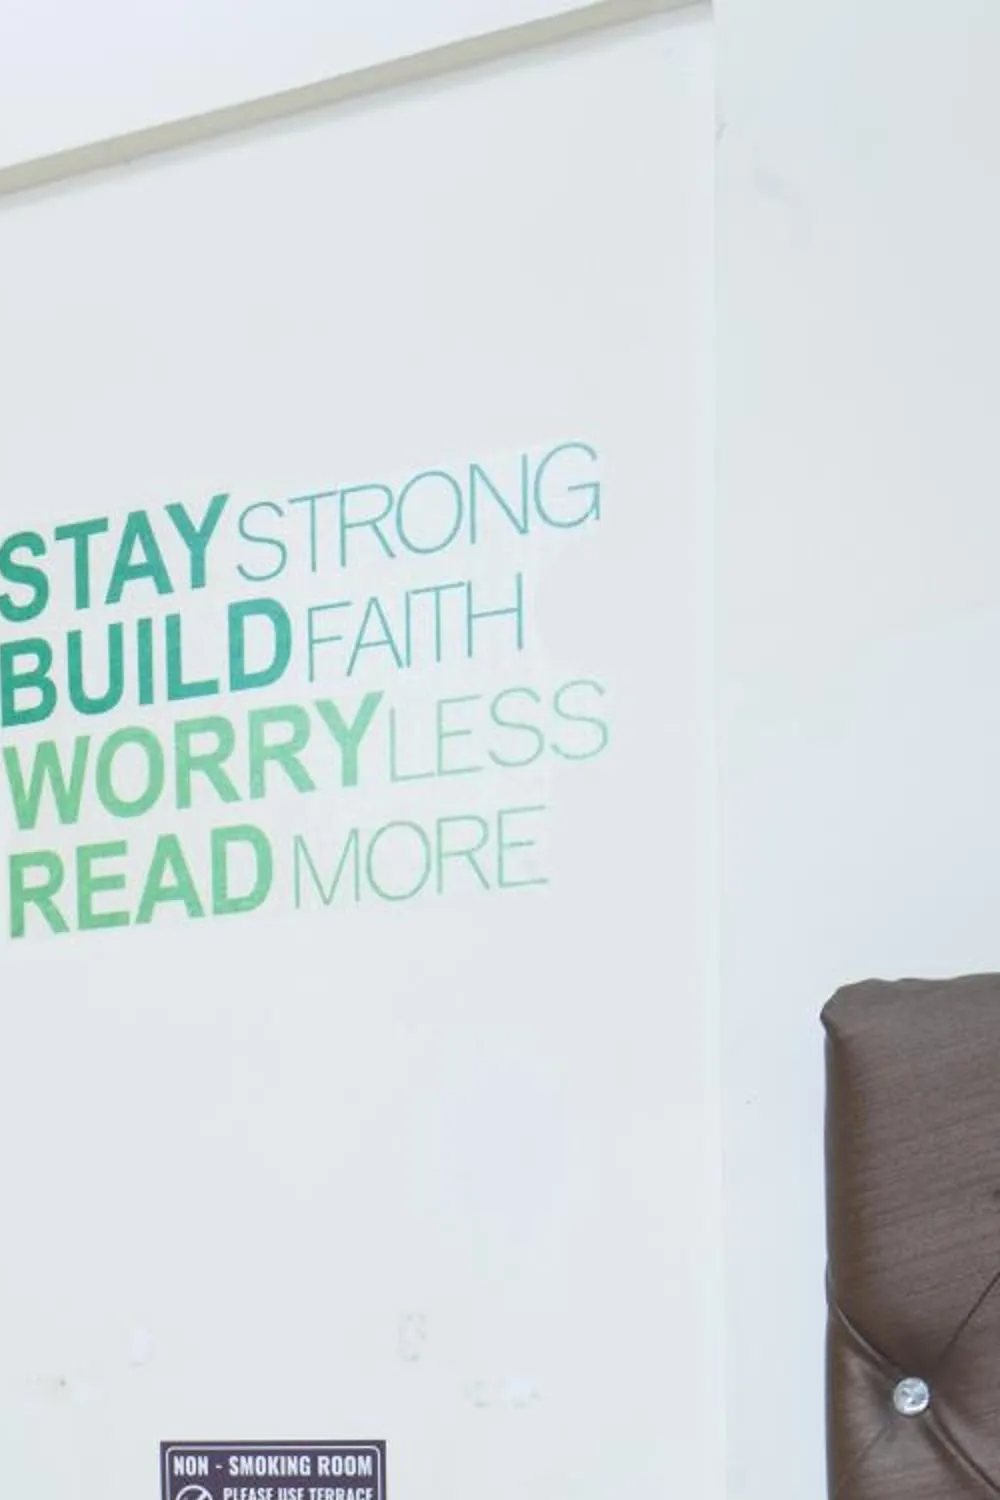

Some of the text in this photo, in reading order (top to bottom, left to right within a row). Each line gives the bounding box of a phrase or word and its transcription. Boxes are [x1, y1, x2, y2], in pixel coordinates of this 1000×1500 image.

[236, 441, 601, 583] STRONG
[0, 571, 524, 728] BUILD FAITH
[2, 679, 609, 831] WORRY LESS
[8, 804, 549, 939] READ MORE
[173, 1455, 209, 1476] NON
[229, 1455, 311, 1477] SMOKING
[317, 1455, 373, 1476] ROOM
